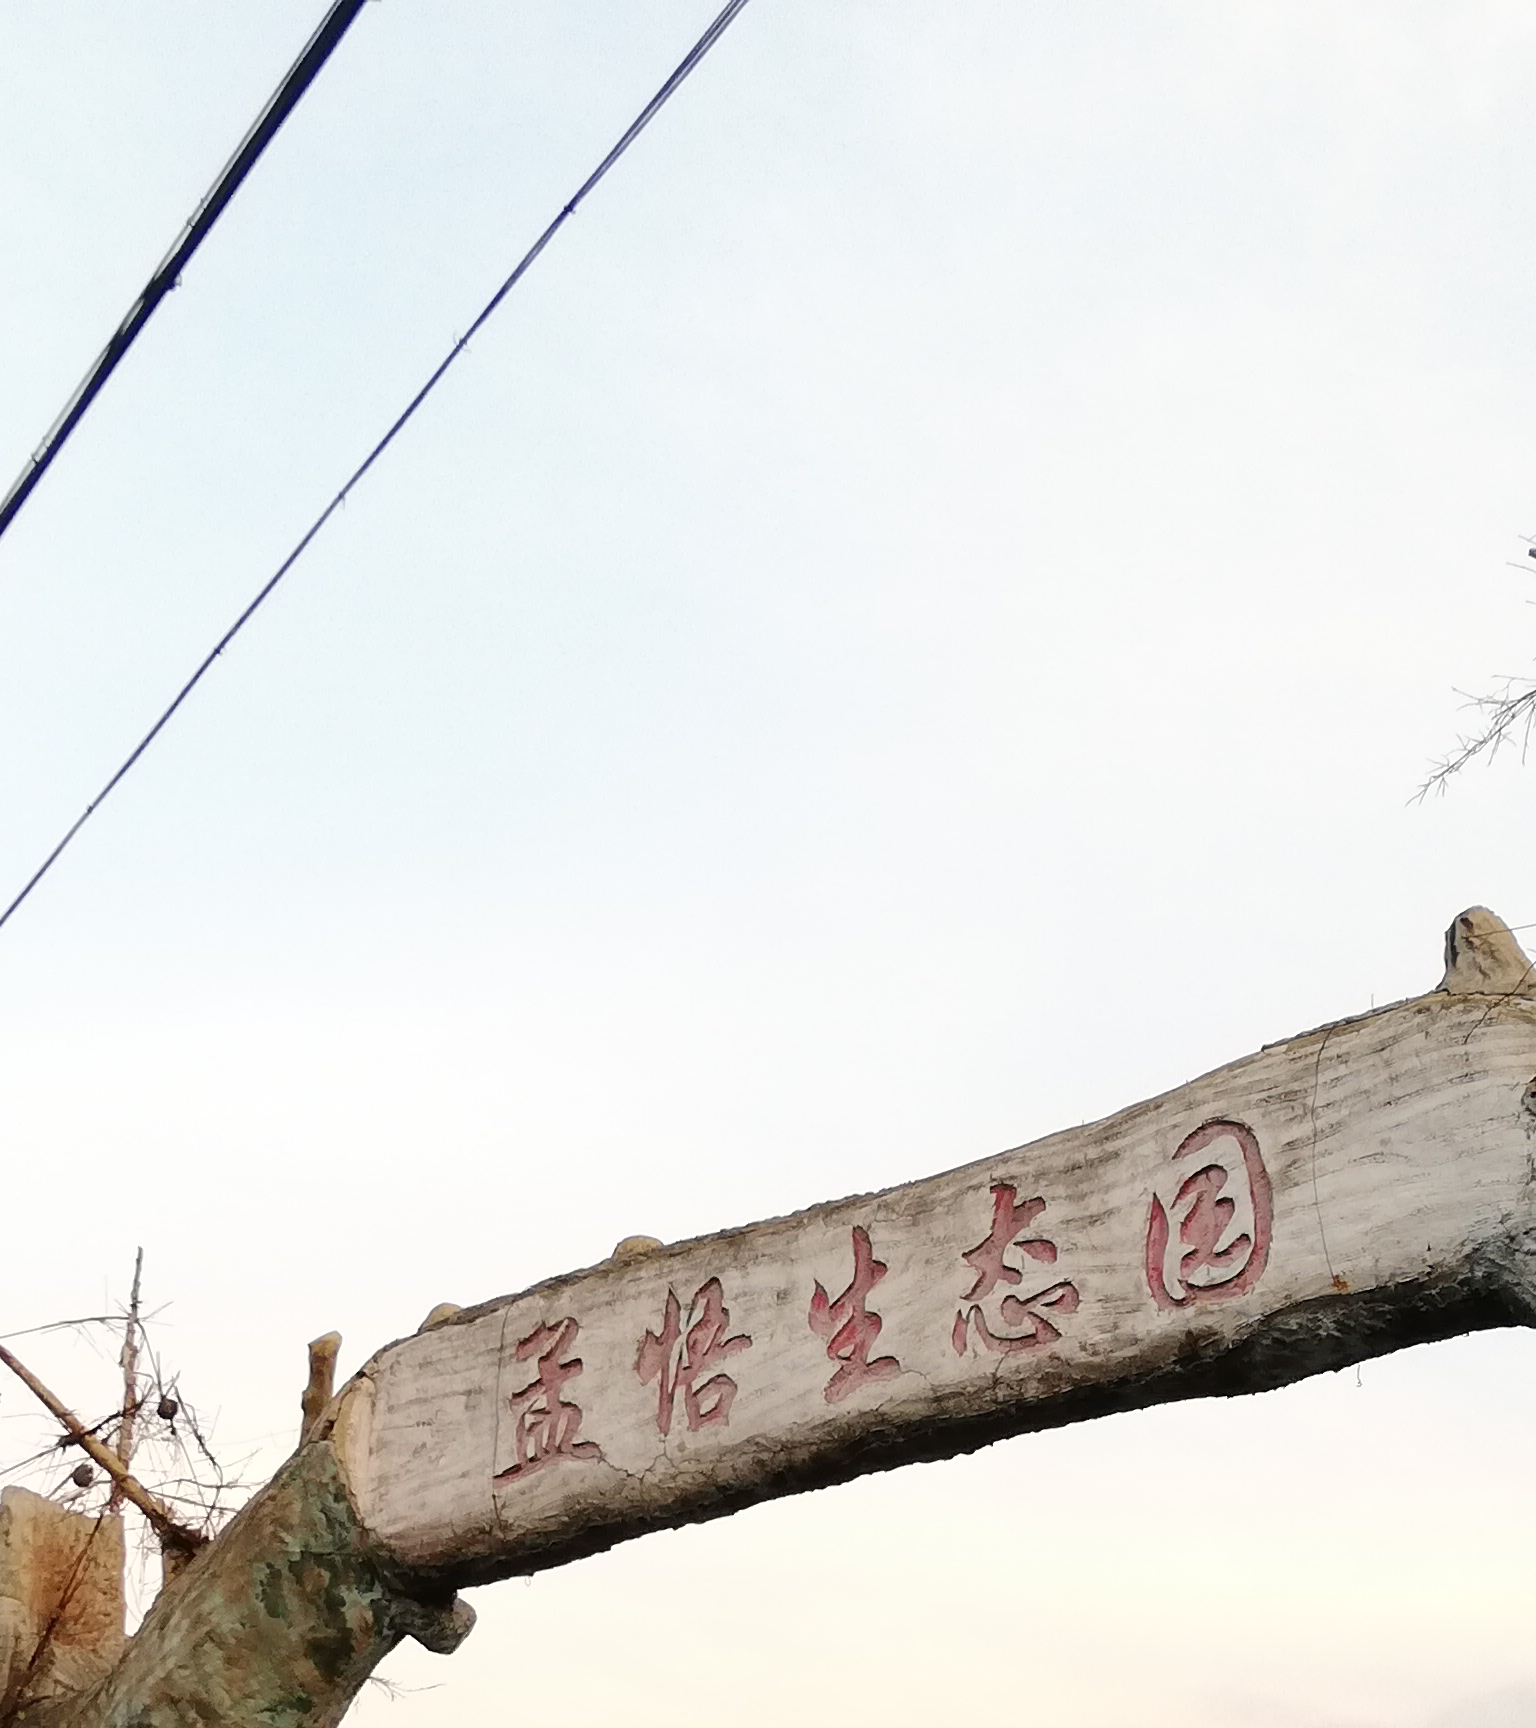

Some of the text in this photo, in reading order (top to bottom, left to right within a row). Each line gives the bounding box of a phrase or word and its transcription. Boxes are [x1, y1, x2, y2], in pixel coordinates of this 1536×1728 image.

[492, 1118, 1275, 1489] 孟悟生态园
